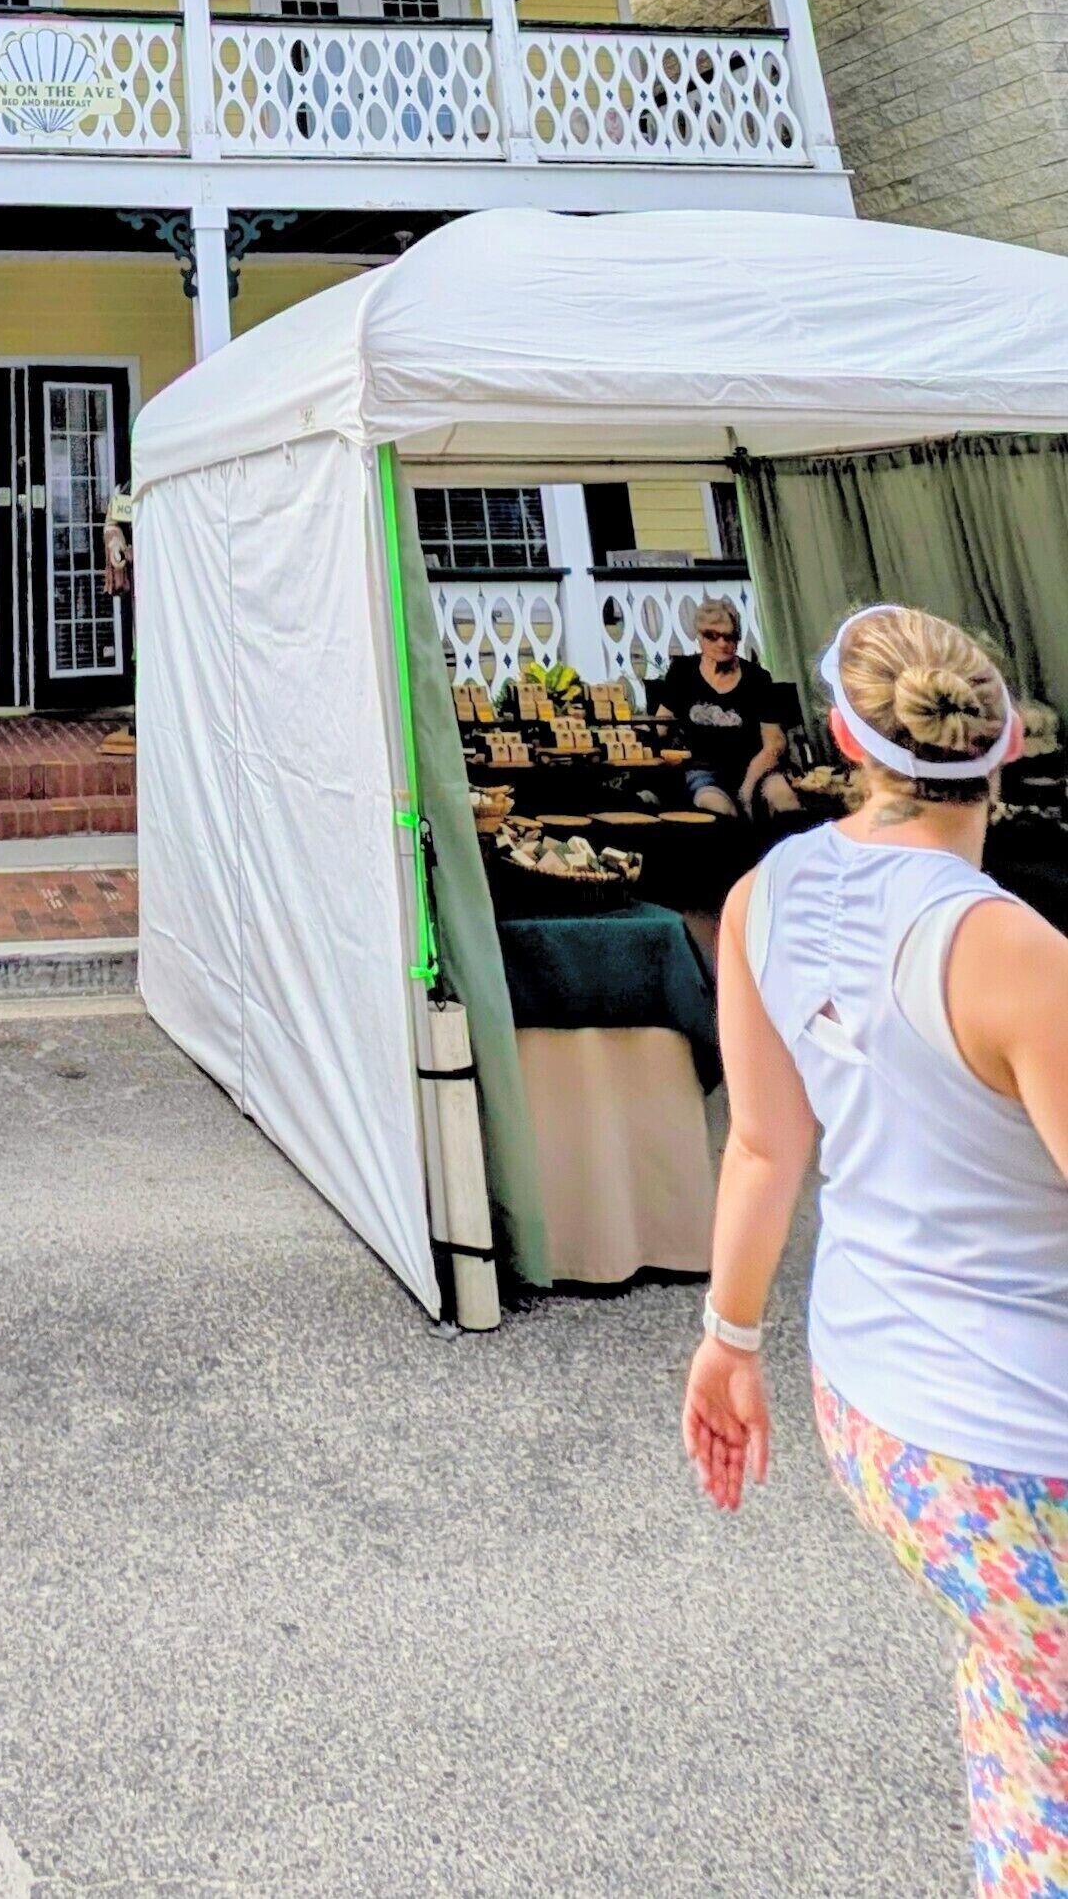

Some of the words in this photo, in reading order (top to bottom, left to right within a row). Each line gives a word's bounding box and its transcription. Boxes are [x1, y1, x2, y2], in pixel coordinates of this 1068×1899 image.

[15, 85, 38, 97] ON
[45, 86, 76, 98] THE
[84, 87, 115, 99] AVE
[2, 98, 19, 106] BED
[22, 98, 41, 107] AND
[43, 99, 92, 108] BREAKFAST
